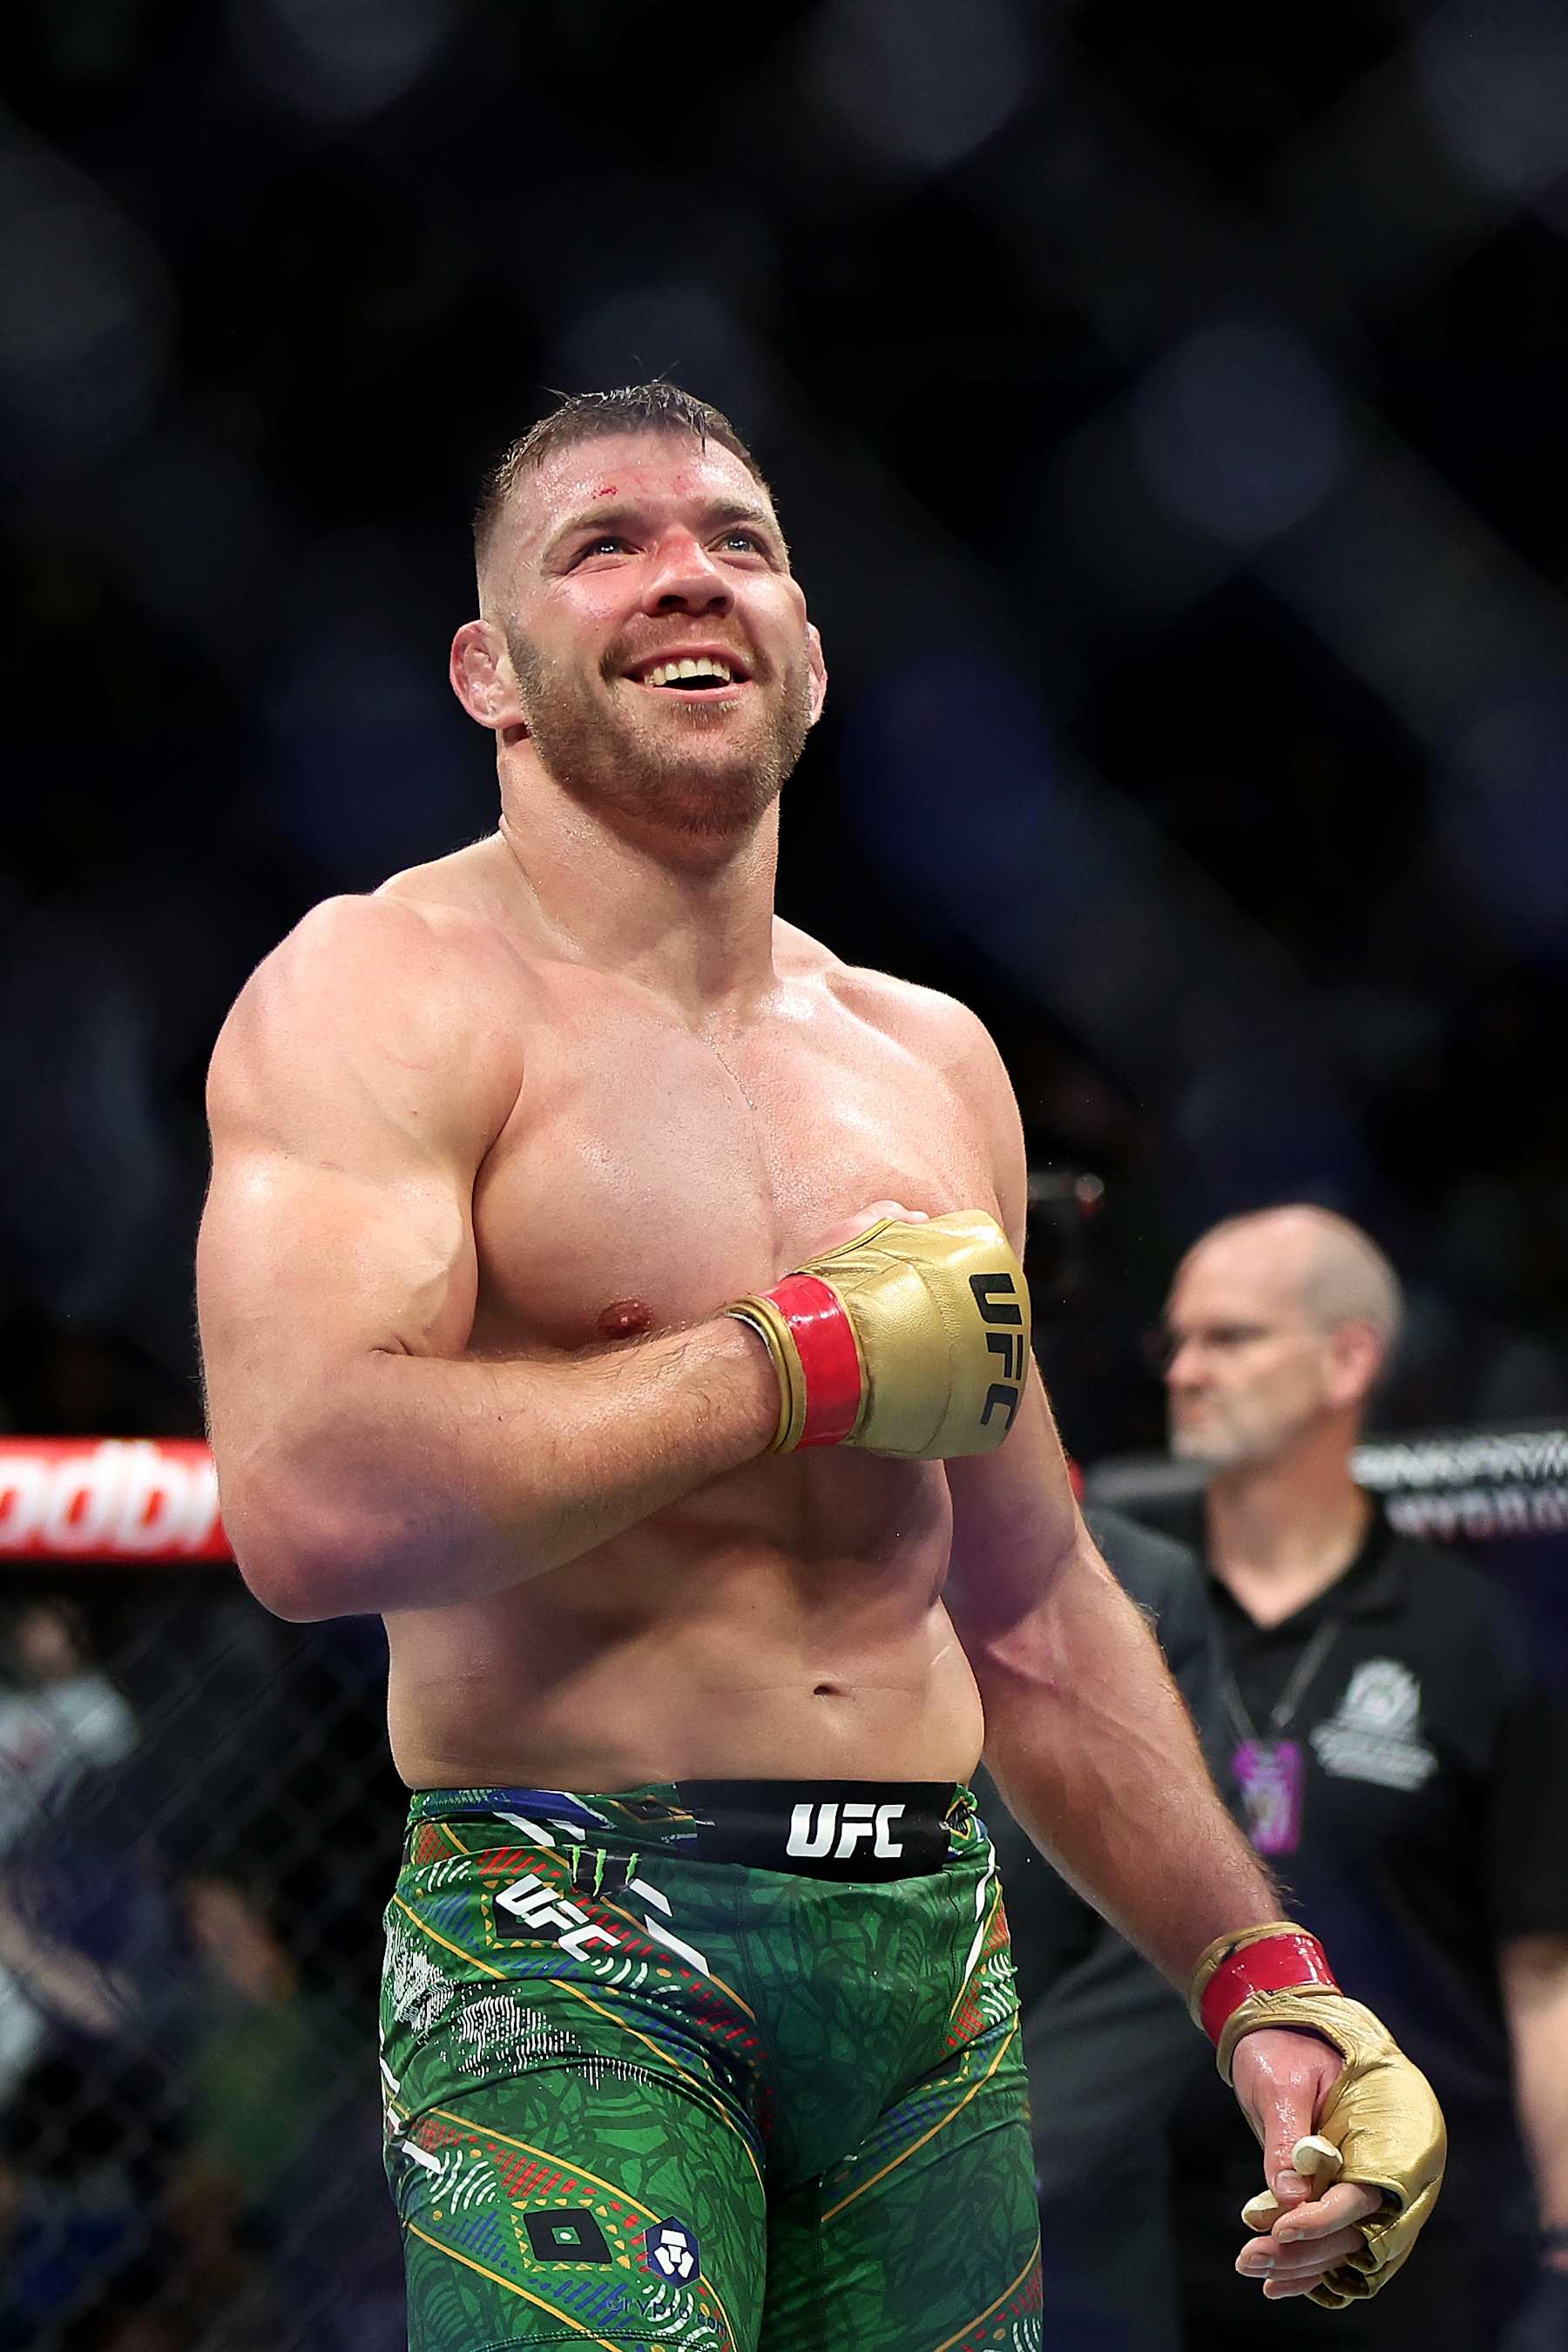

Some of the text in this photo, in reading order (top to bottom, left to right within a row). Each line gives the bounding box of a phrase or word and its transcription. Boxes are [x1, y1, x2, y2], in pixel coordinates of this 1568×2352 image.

[970, 1274, 1024, 1429] UFC
[787, 1803, 906, 1858] UFC
[495, 1873, 622, 1962] UFC
